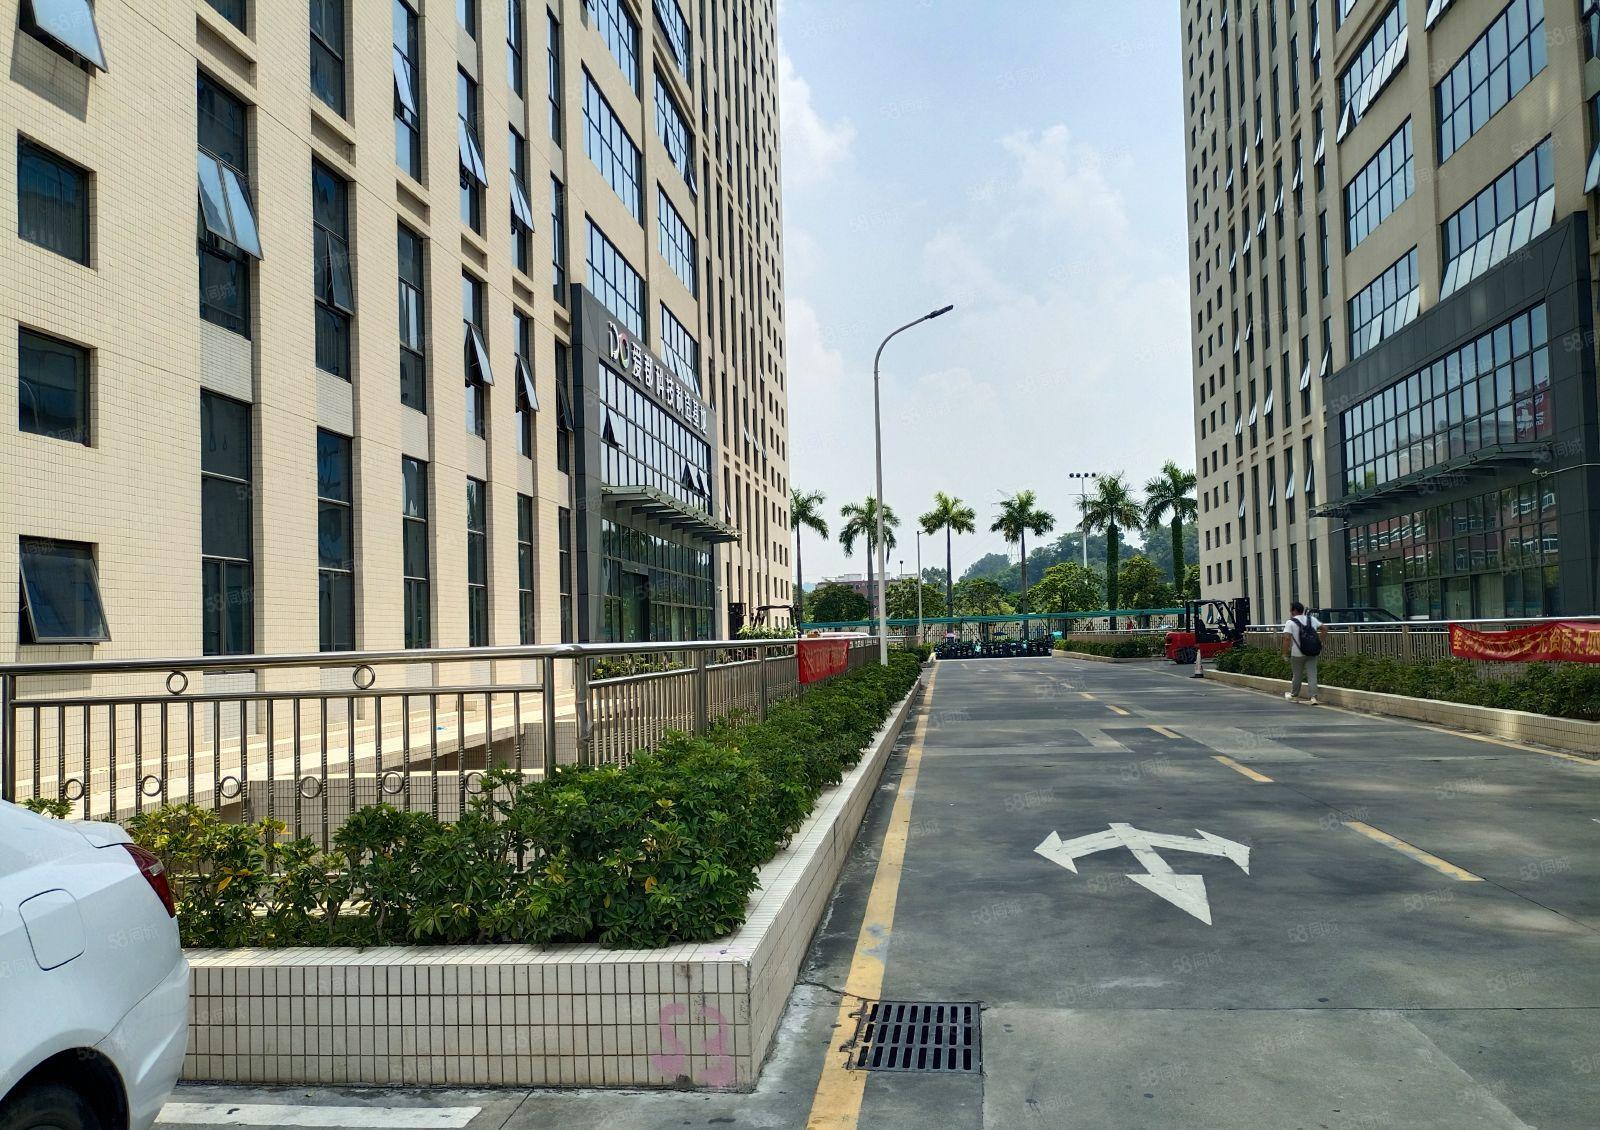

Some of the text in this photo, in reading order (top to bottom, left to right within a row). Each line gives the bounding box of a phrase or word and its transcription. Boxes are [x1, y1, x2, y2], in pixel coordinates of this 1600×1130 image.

[631, 341, 708, 435] 爱都科技制造基地
